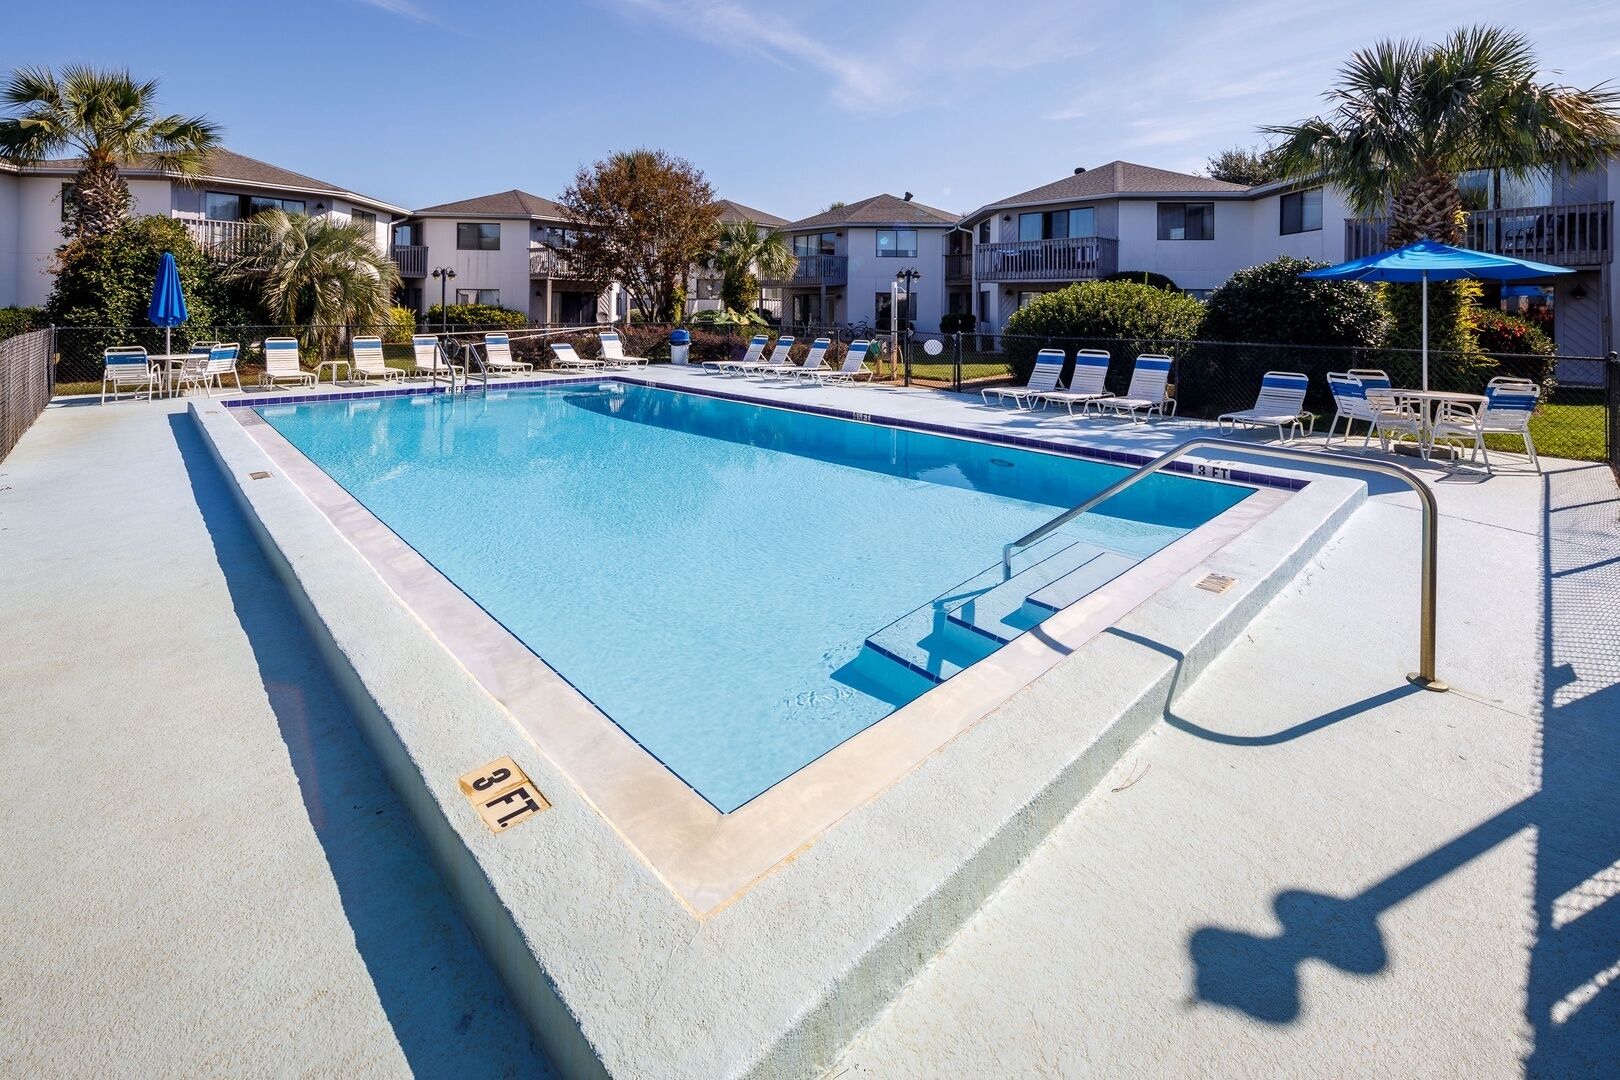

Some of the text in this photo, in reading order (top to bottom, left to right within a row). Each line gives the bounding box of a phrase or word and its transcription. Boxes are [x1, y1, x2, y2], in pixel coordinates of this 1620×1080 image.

[1198, 465, 1228, 479] 3 FT
[472, 768, 511, 791] 3
